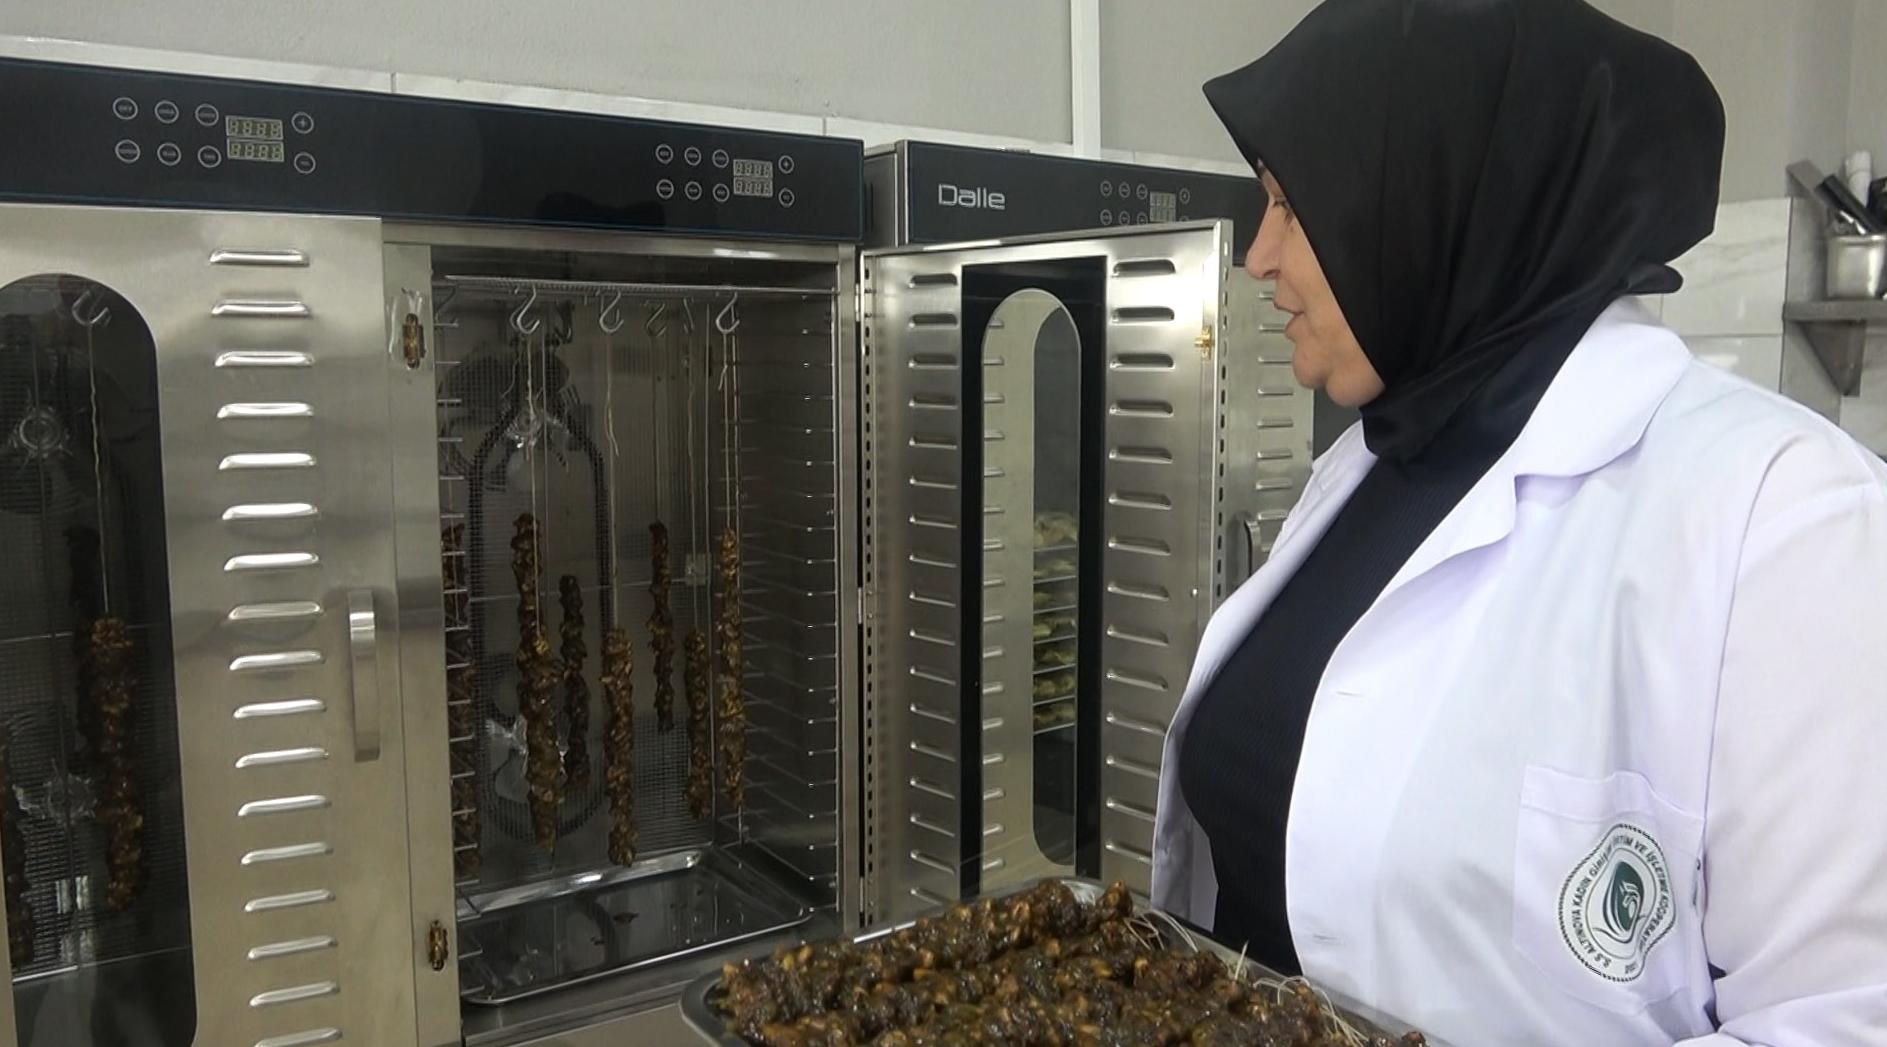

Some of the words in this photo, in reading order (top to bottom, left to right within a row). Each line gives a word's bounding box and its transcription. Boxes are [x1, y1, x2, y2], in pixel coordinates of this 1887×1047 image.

[938, 183, 1006, 210] Dalle
[1571, 877, 1592, 908] KADIN
[1633, 840, 1649, 855] VE
